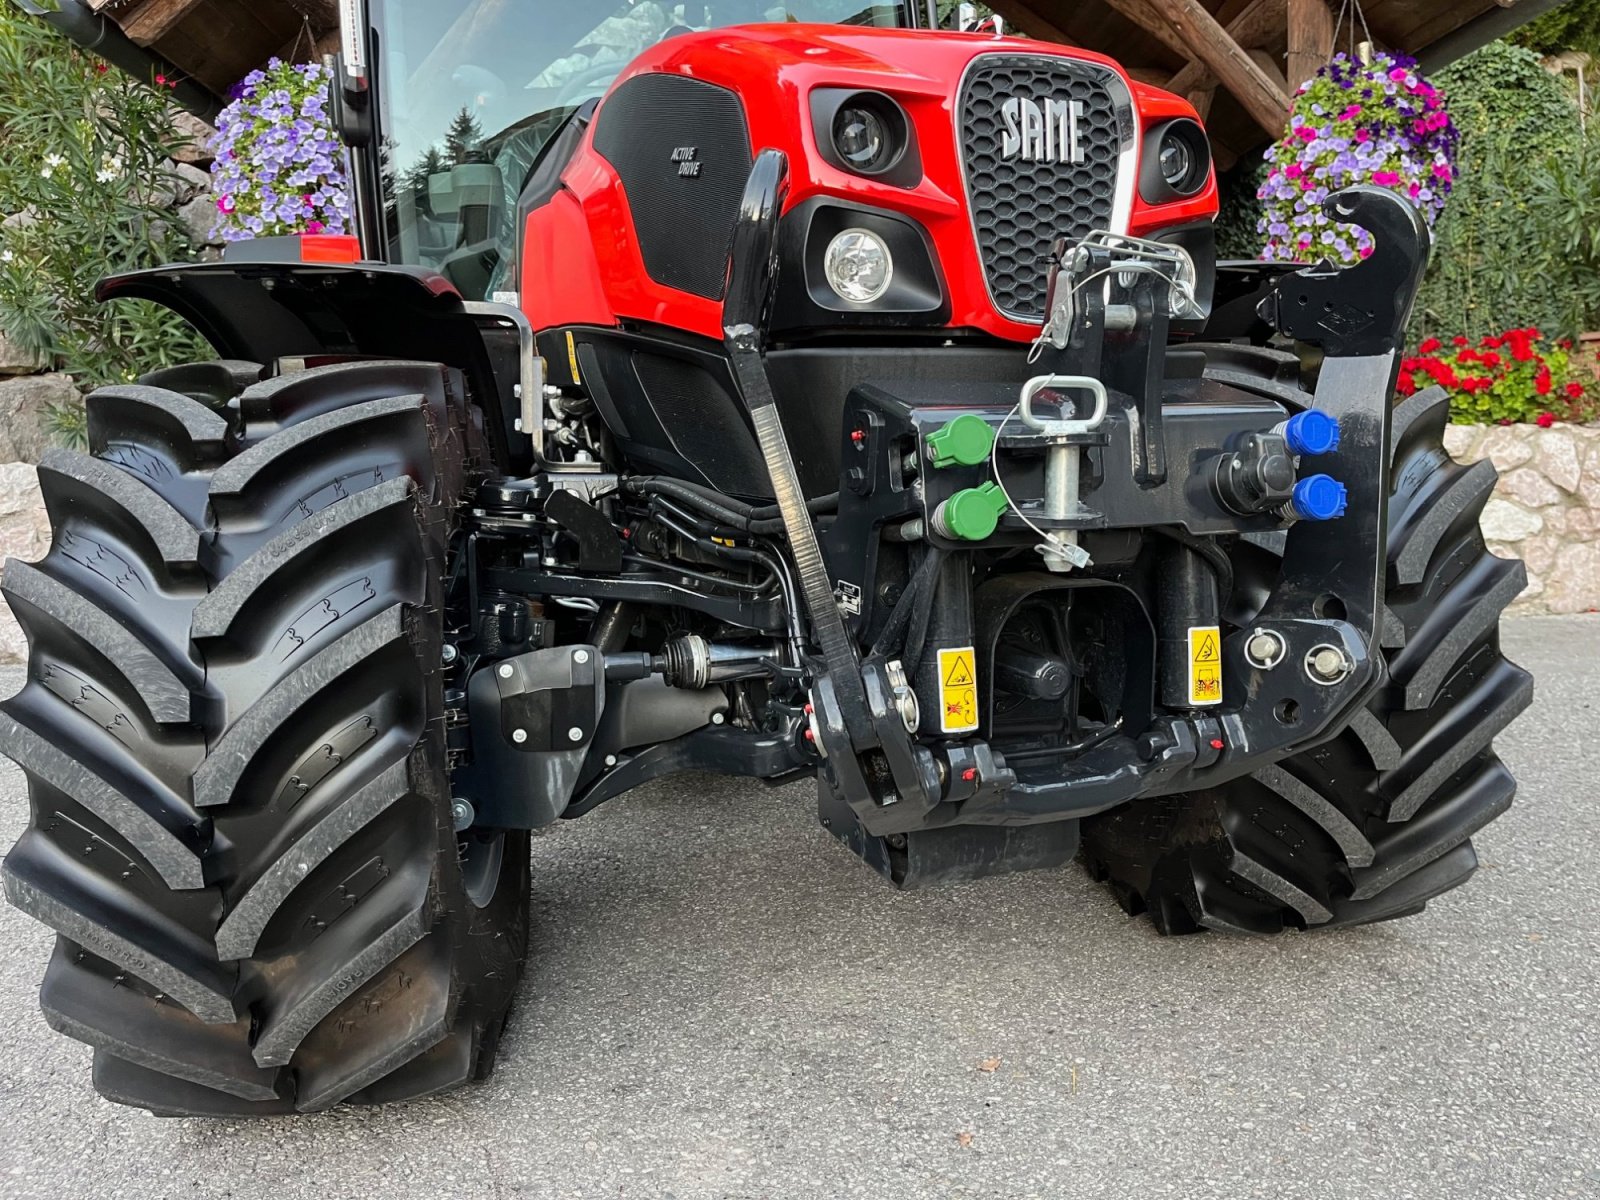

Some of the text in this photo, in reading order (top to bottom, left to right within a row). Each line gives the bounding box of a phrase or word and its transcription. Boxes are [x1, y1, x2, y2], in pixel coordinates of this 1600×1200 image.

[1002, 97, 1085, 163] SAME
[670, 146, 696, 160] ACTIVE
[678, 161, 700, 176] DRIVE
